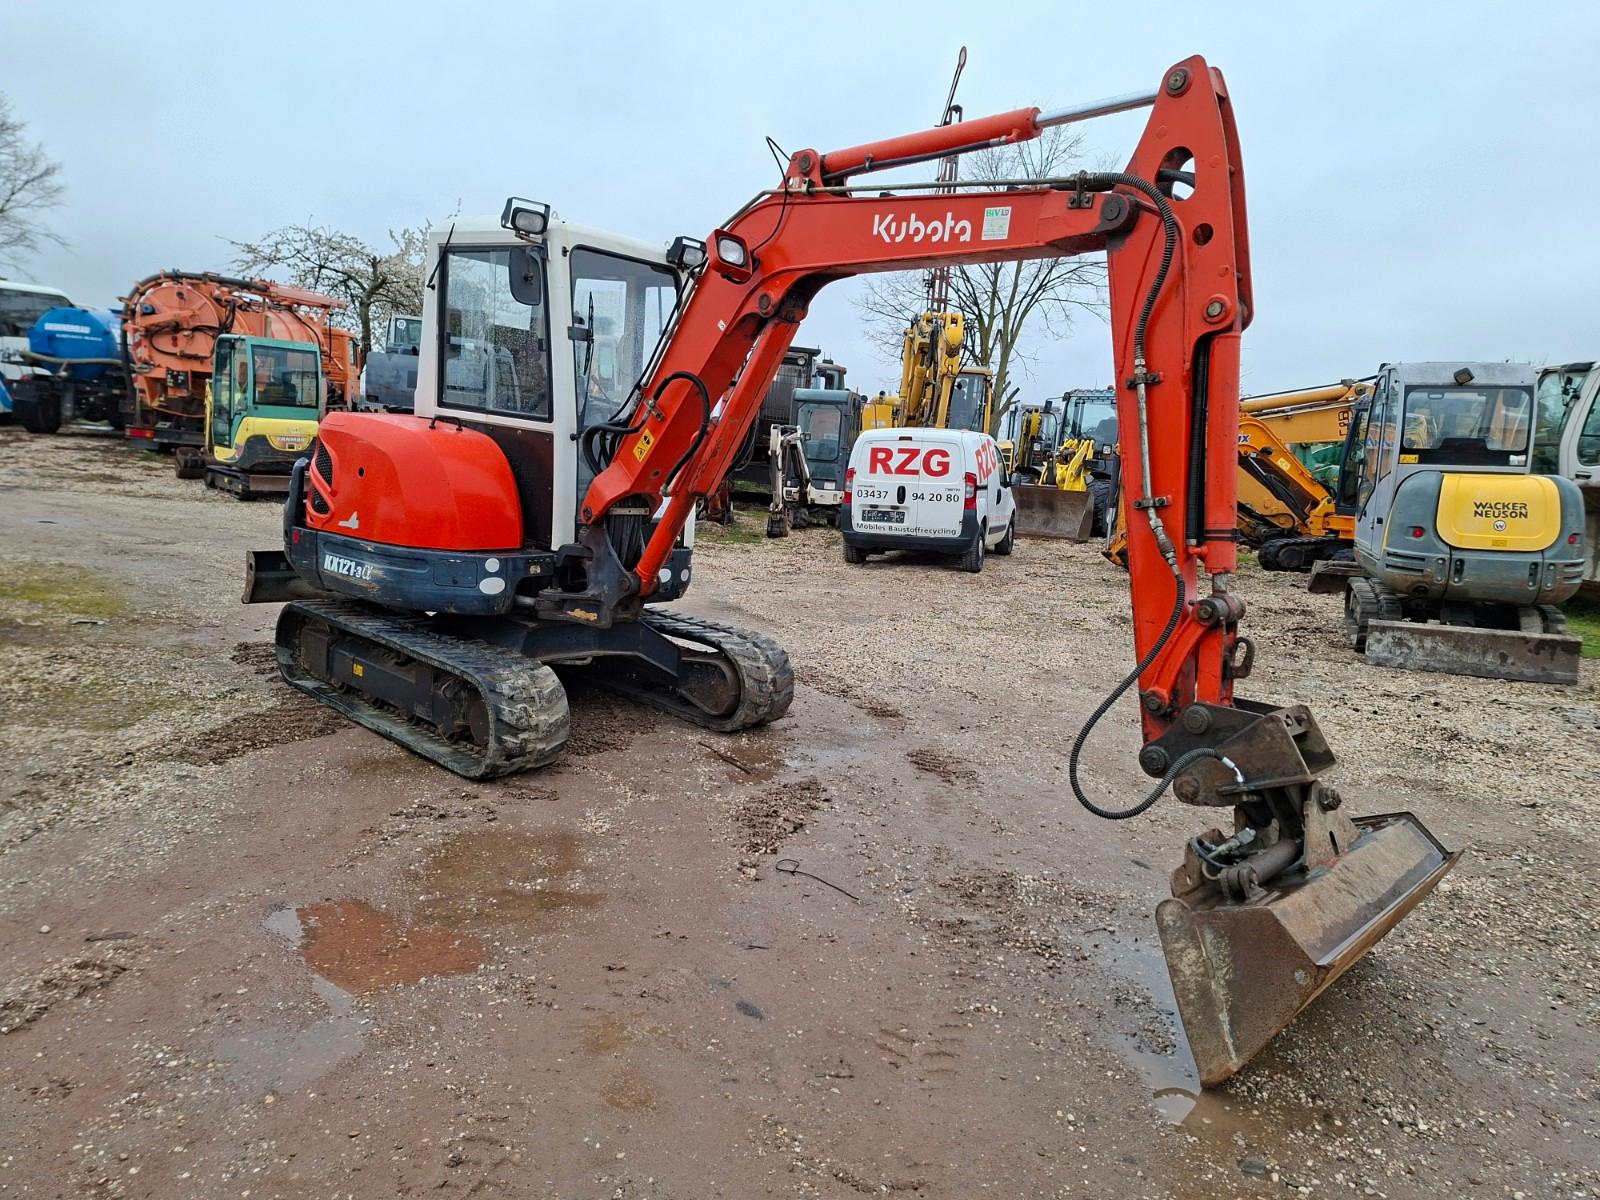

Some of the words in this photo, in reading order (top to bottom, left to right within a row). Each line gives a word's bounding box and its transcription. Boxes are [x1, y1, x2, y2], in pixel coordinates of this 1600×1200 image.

[872, 212, 972, 243] Kubota
[868, 447, 950, 477] RZG
[975, 438, 997, 482] RZG
[857, 489, 889, 499] 03437
[911, 492, 925, 501] 94
[928, 493, 942, 502] 20
[945, 494, 960, 503] 80
[1473, 502, 1528, 511] WACKER
[1473, 510, 1529, 519] NEUSON
[856, 522, 886, 532] Mobiles
[888, 525, 957, 536] Baustoffrecycling
